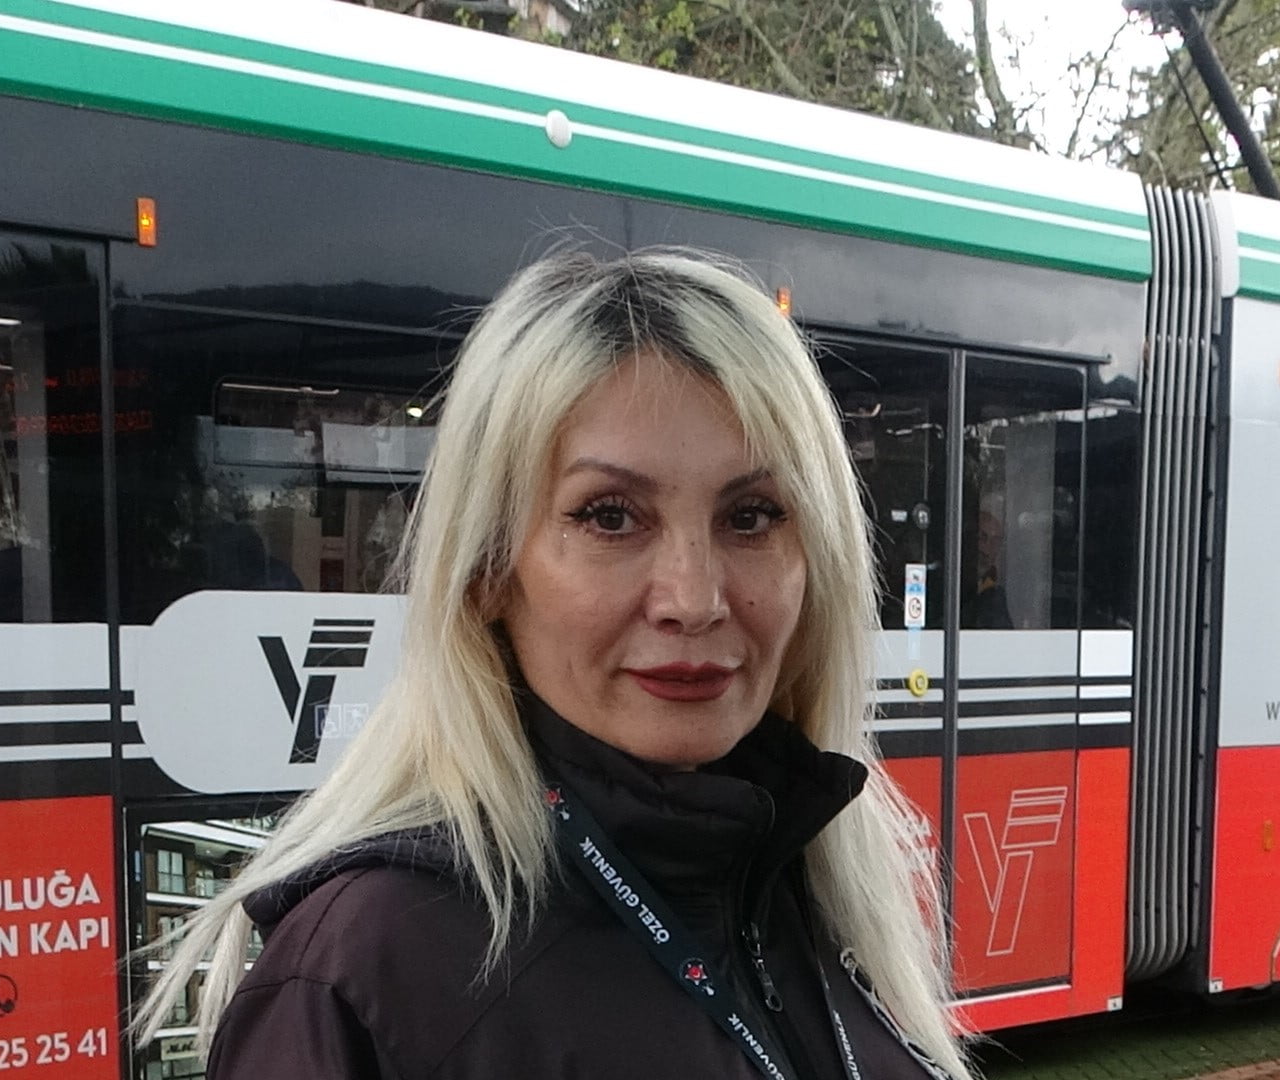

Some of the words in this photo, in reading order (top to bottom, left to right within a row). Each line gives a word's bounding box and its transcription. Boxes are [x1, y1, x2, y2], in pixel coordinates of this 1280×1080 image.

[579, 836, 640, 908] GÜVENLİK
[30, 916, 110, 955] KAPI
[637, 904, 670, 944] ÖZEL
[36, 1032, 70, 1065] 25
[77, 1027, 108, 1058] 41
